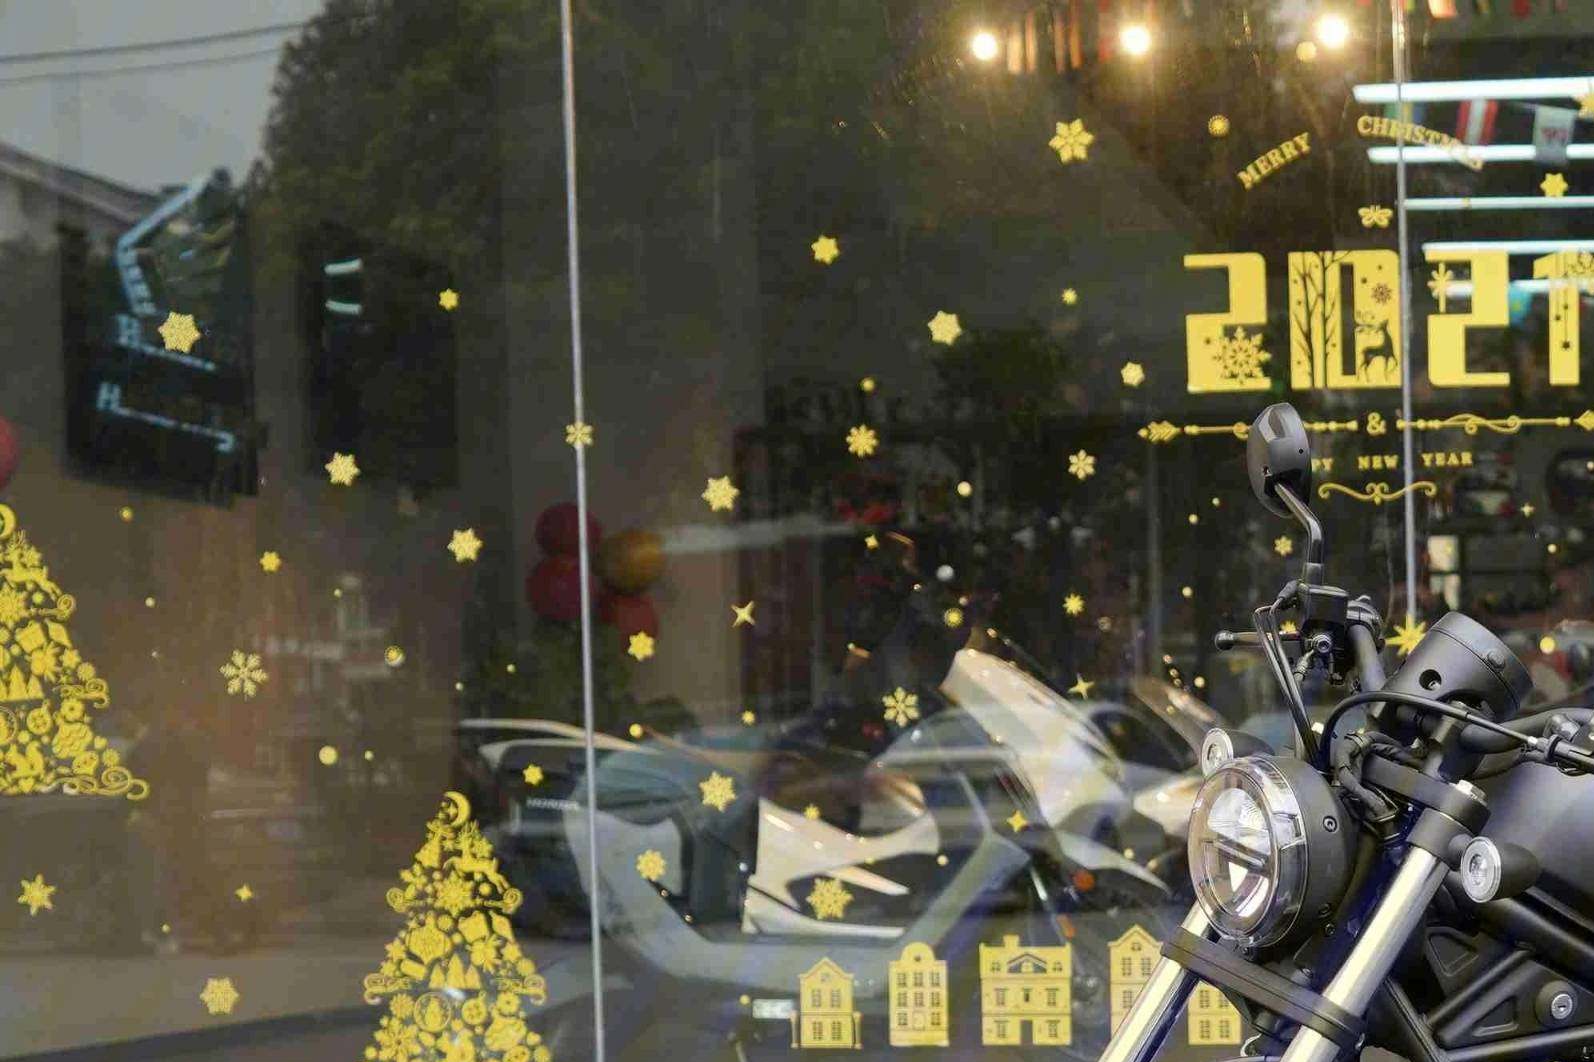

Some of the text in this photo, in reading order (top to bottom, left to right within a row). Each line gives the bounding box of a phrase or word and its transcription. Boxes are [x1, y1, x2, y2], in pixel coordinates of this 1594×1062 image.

[1237, 131, 1311, 191] MERRY
[1183, 249, 1584, 394] 2021
[1366, 411, 1387, 437] &
[1357, 451, 1474, 471] NEW YEAR
